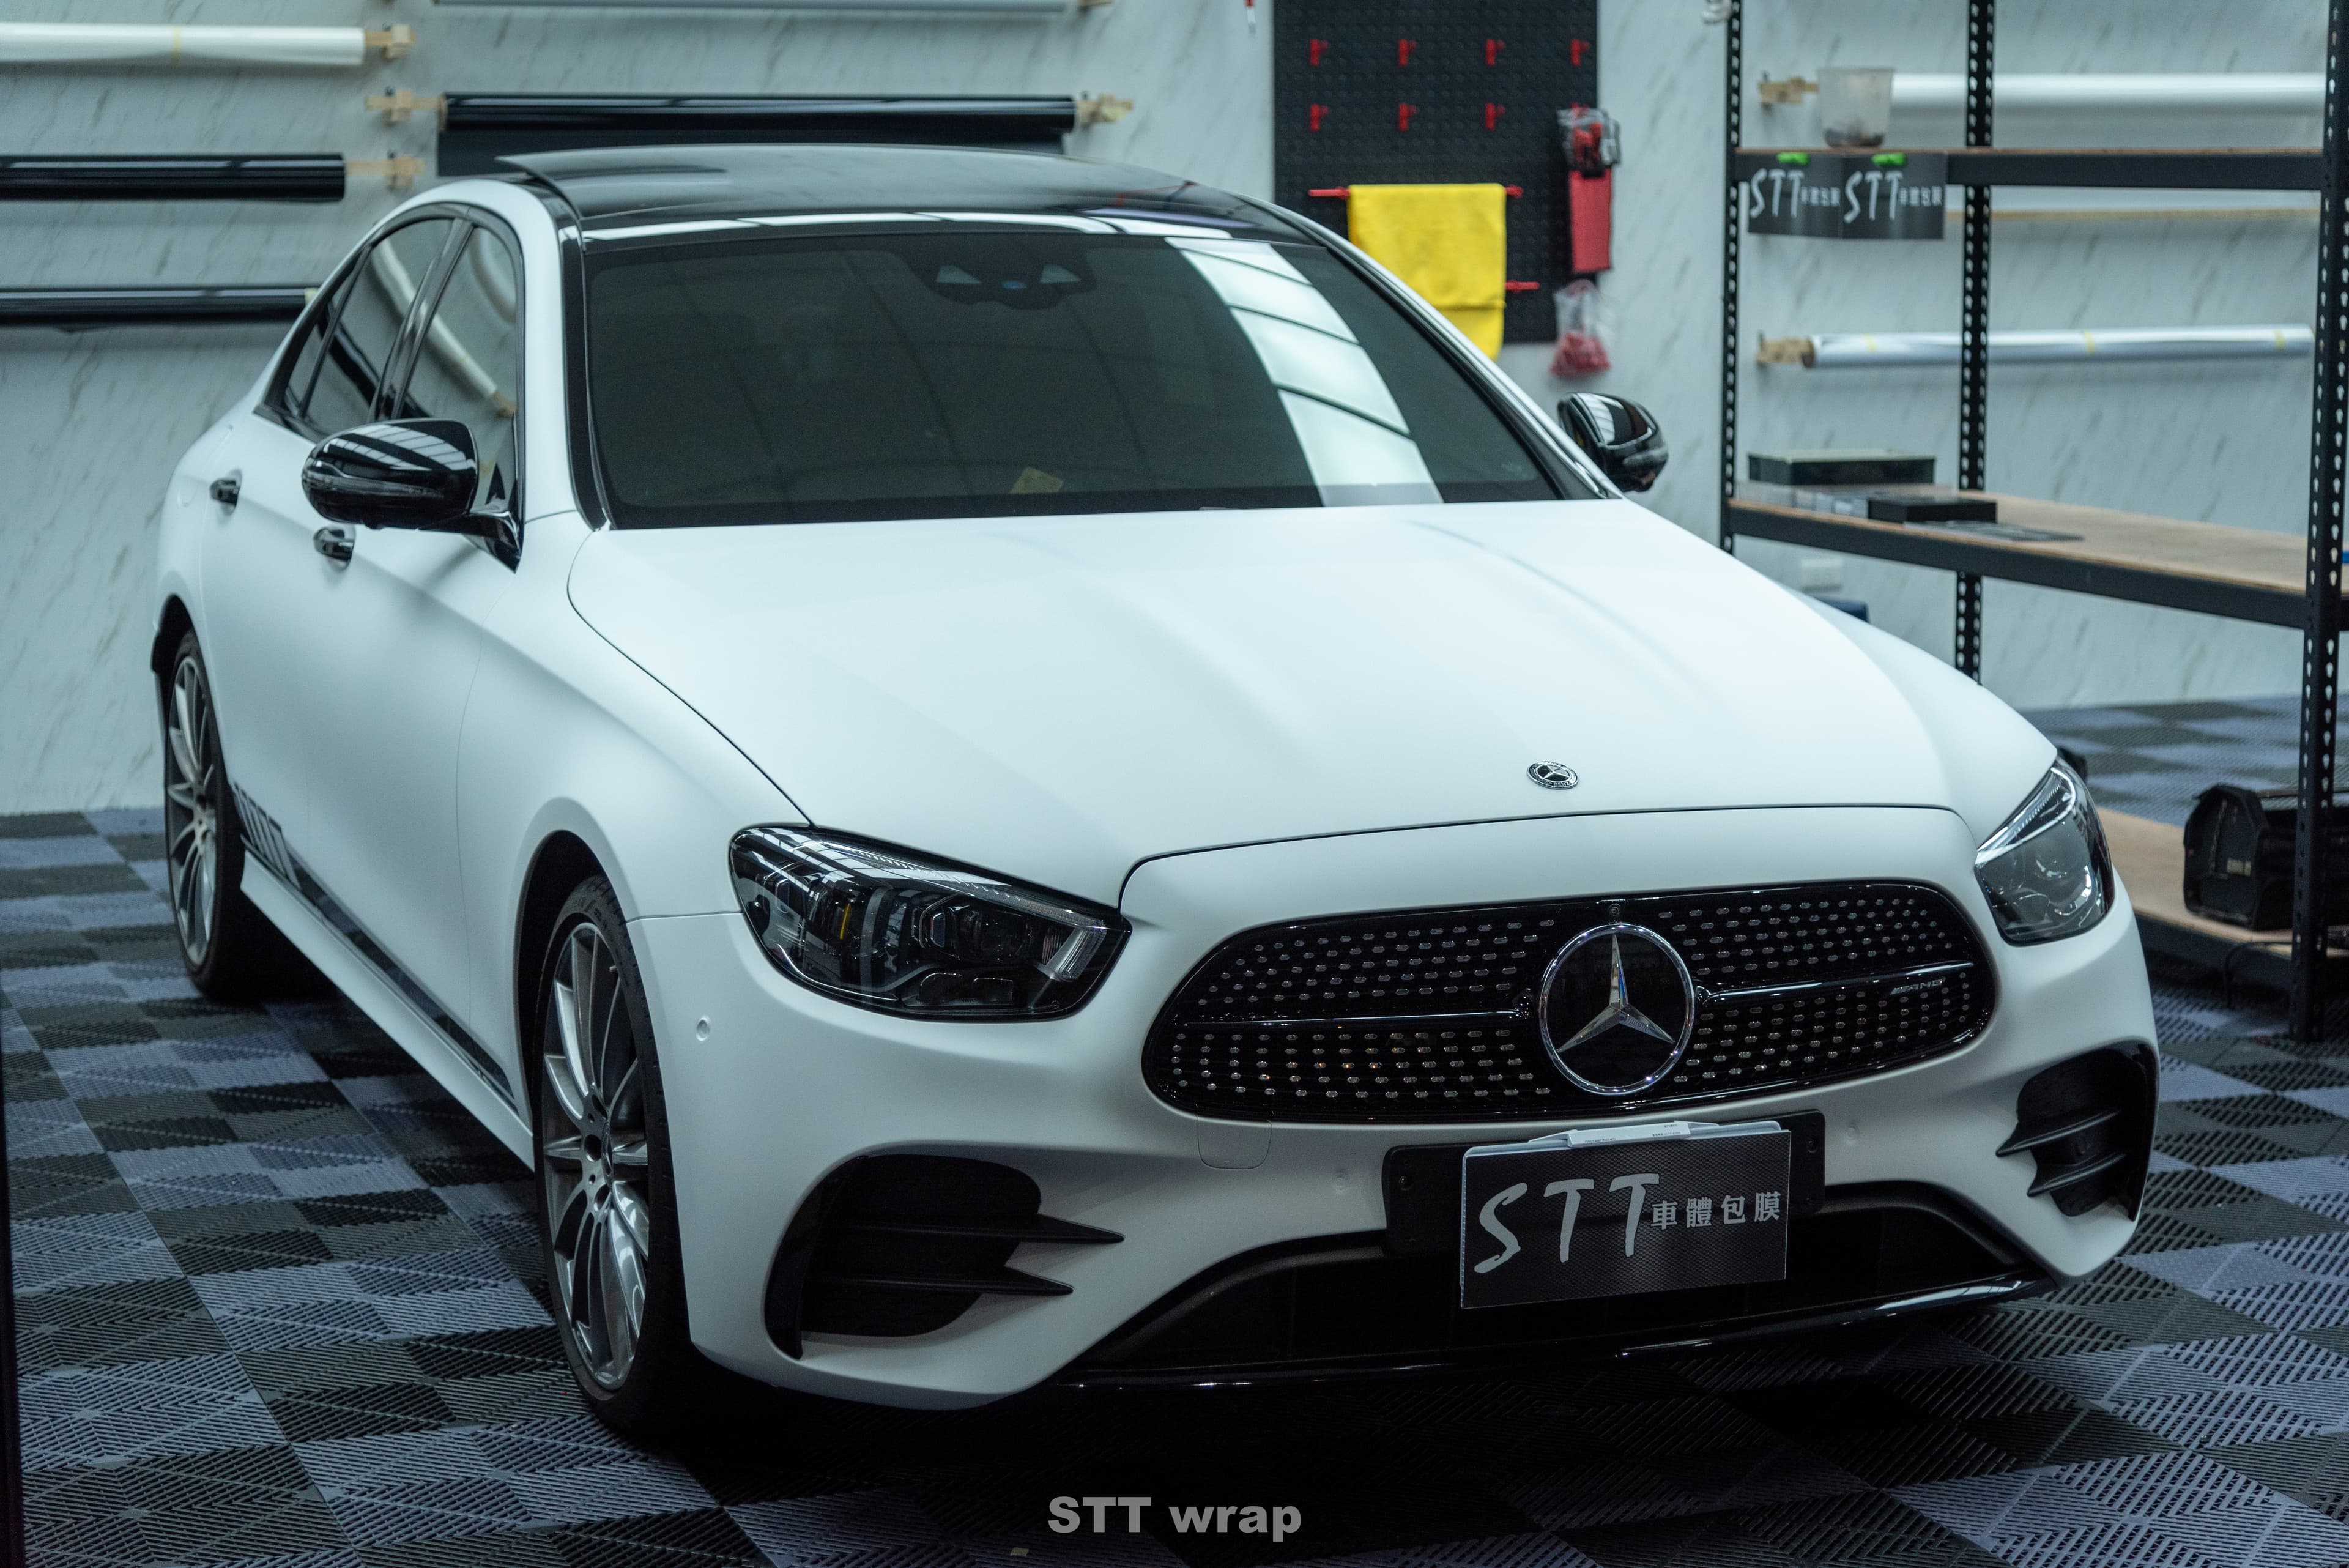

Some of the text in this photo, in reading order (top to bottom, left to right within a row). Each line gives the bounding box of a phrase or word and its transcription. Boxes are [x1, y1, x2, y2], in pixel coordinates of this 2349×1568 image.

[1750, 168, 1804, 218] STT
[1844, 171, 1903, 223] STT
[1474, 1173, 1780, 1274] STT 車體包膜
